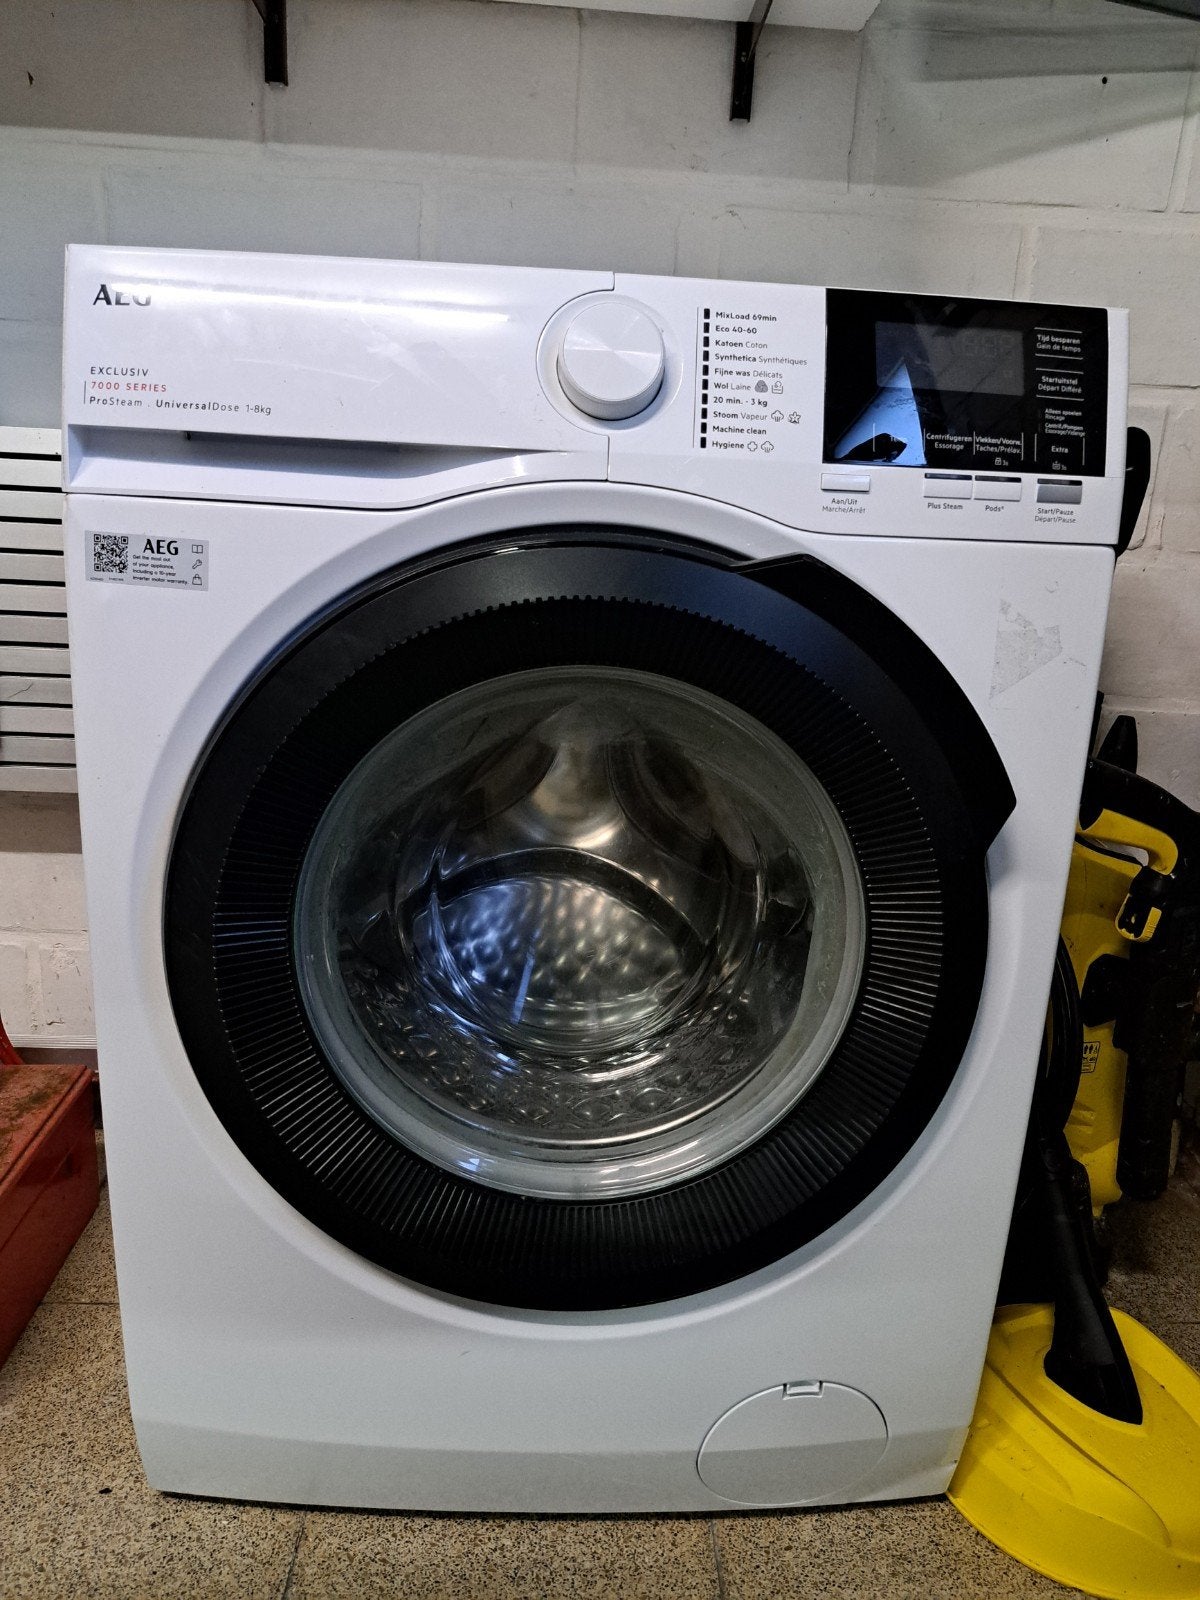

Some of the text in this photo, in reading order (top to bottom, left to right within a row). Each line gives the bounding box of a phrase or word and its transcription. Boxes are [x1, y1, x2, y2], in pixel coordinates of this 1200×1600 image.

[716, 312, 777, 322] MixLoad 69min
[716, 325, 757, 334] Eco 40-60
[715, 339, 768, 349] Katoen Coton
[1037, 334, 1080, 345] Tijd besparen
[1037, 342, 1051, 350] Gain
[1062, 344, 1081, 353] temps
[715, 353, 807, 366] Synthetica Synthétiques
[90, 366, 149, 377] EXCLUSIV
[714, 368, 733, 377] Fijne
[753, 370, 783, 379] Délicats
[1041, 376, 1078, 385] Startuitstel
[91, 381, 167, 393] 7000 SERIES
[714, 382, 751, 391] Wol Laine
[1038, 383, 1082, 394] Départ Différé
[89, 396, 142, 407] ProSteam
[156, 399, 239, 412] UniversalDose
[246, 404, 272, 416] 1-8kg
[713, 396, 724, 404] 20
[726, 397, 743, 405] min.
[757, 398, 768, 407] kg
[713, 411, 767, 421] Stoom Vapeur
[712, 425, 767, 435] Machine clean
[926, 433, 972, 443] Centrifugeren
[712, 441, 745, 449] Hygiene
[934, 442, 964, 451] Essorage
[1051, 445, 1069, 453] Extra
[822, 505, 866, 513] Marche/Arrêt
[927, 502, 941, 510] Plus
[1037, 508, 1074, 516] Start/Pauze
[1034, 515, 1076, 524] Départ/Pause
[143, 538, 179, 555] AEG
